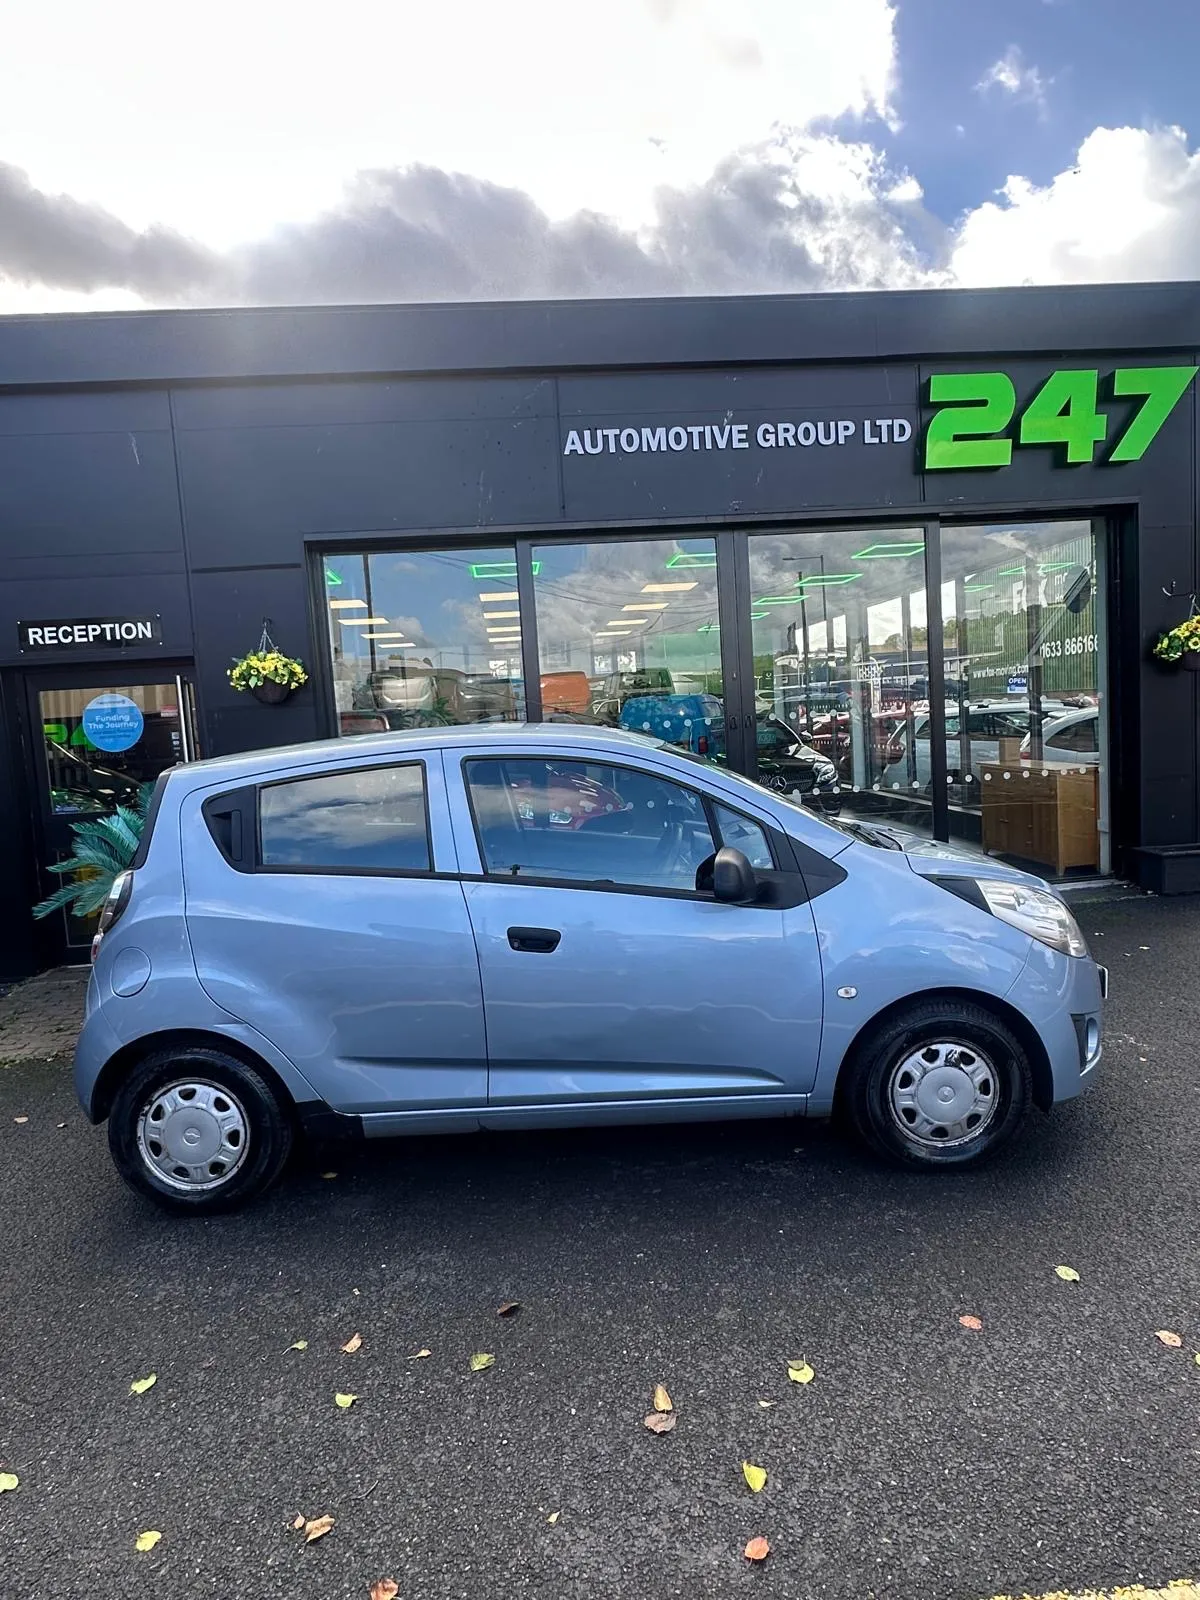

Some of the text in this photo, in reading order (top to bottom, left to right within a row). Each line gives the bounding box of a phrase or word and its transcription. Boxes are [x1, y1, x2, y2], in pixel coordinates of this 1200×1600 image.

[925, 366, 1199, 469] 247
[563, 419, 912, 456] AUTOMOTIVE GROUP LTD
[28, 621, 152, 645] RECEPTION
[1008, 677, 1027, 685] OPEN
[88, 720, 139, 730] The Journey
[95, 714, 130, 722] Funding
